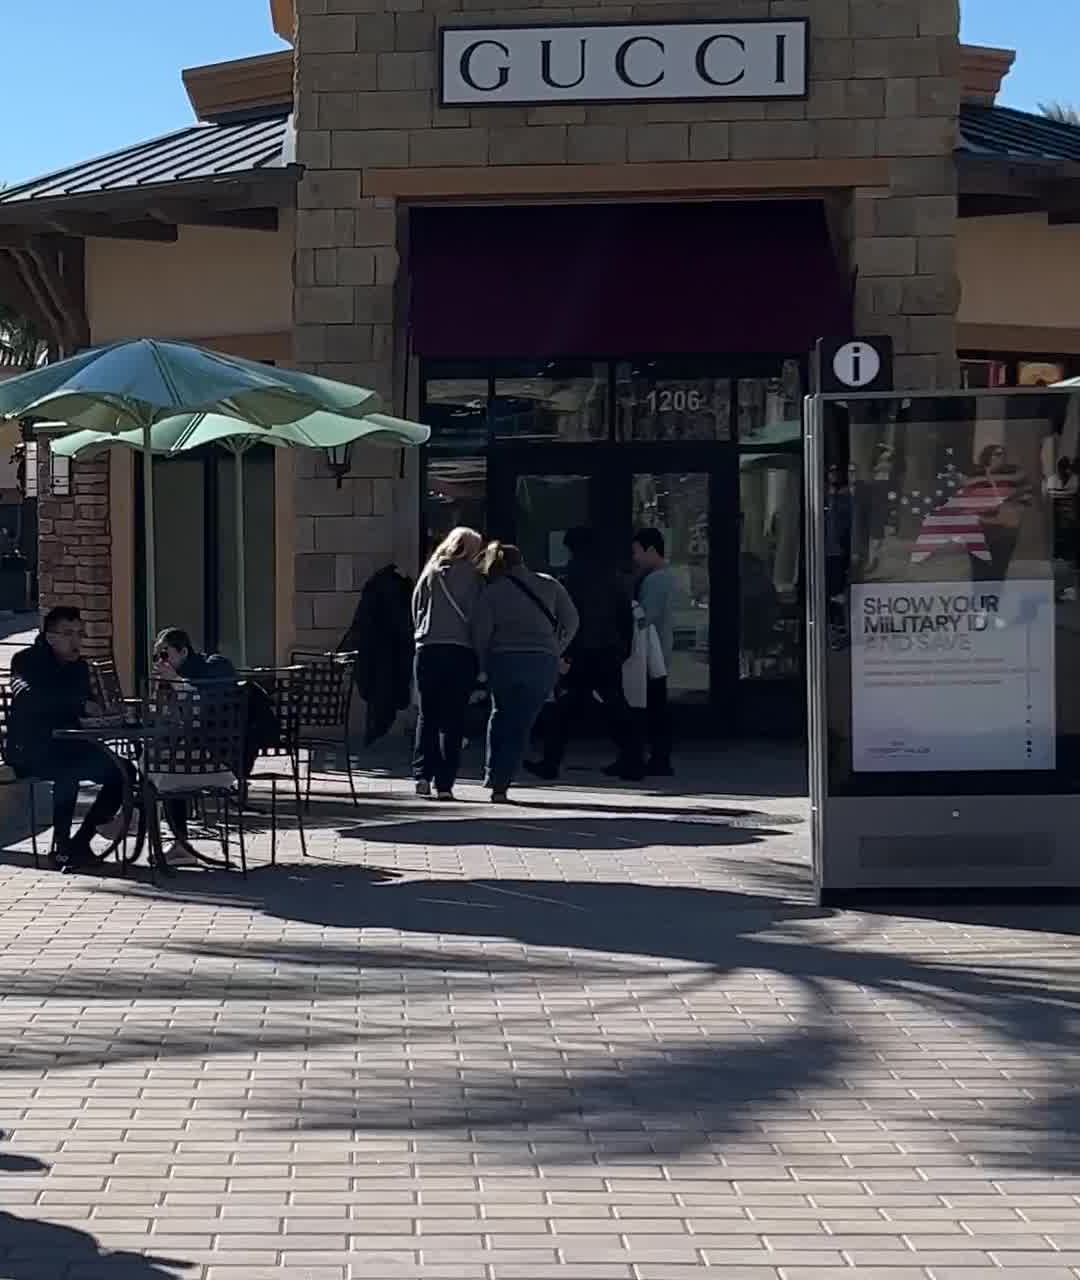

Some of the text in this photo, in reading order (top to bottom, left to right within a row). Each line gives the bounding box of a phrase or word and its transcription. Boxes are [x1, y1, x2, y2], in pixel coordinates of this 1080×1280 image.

[459, 34, 787, 92] GUCCI
[647, 389, 702, 412] 1206
[863, 594, 1000, 616] SHOW YOUR
[863, 614, 961, 634] MILITARY
